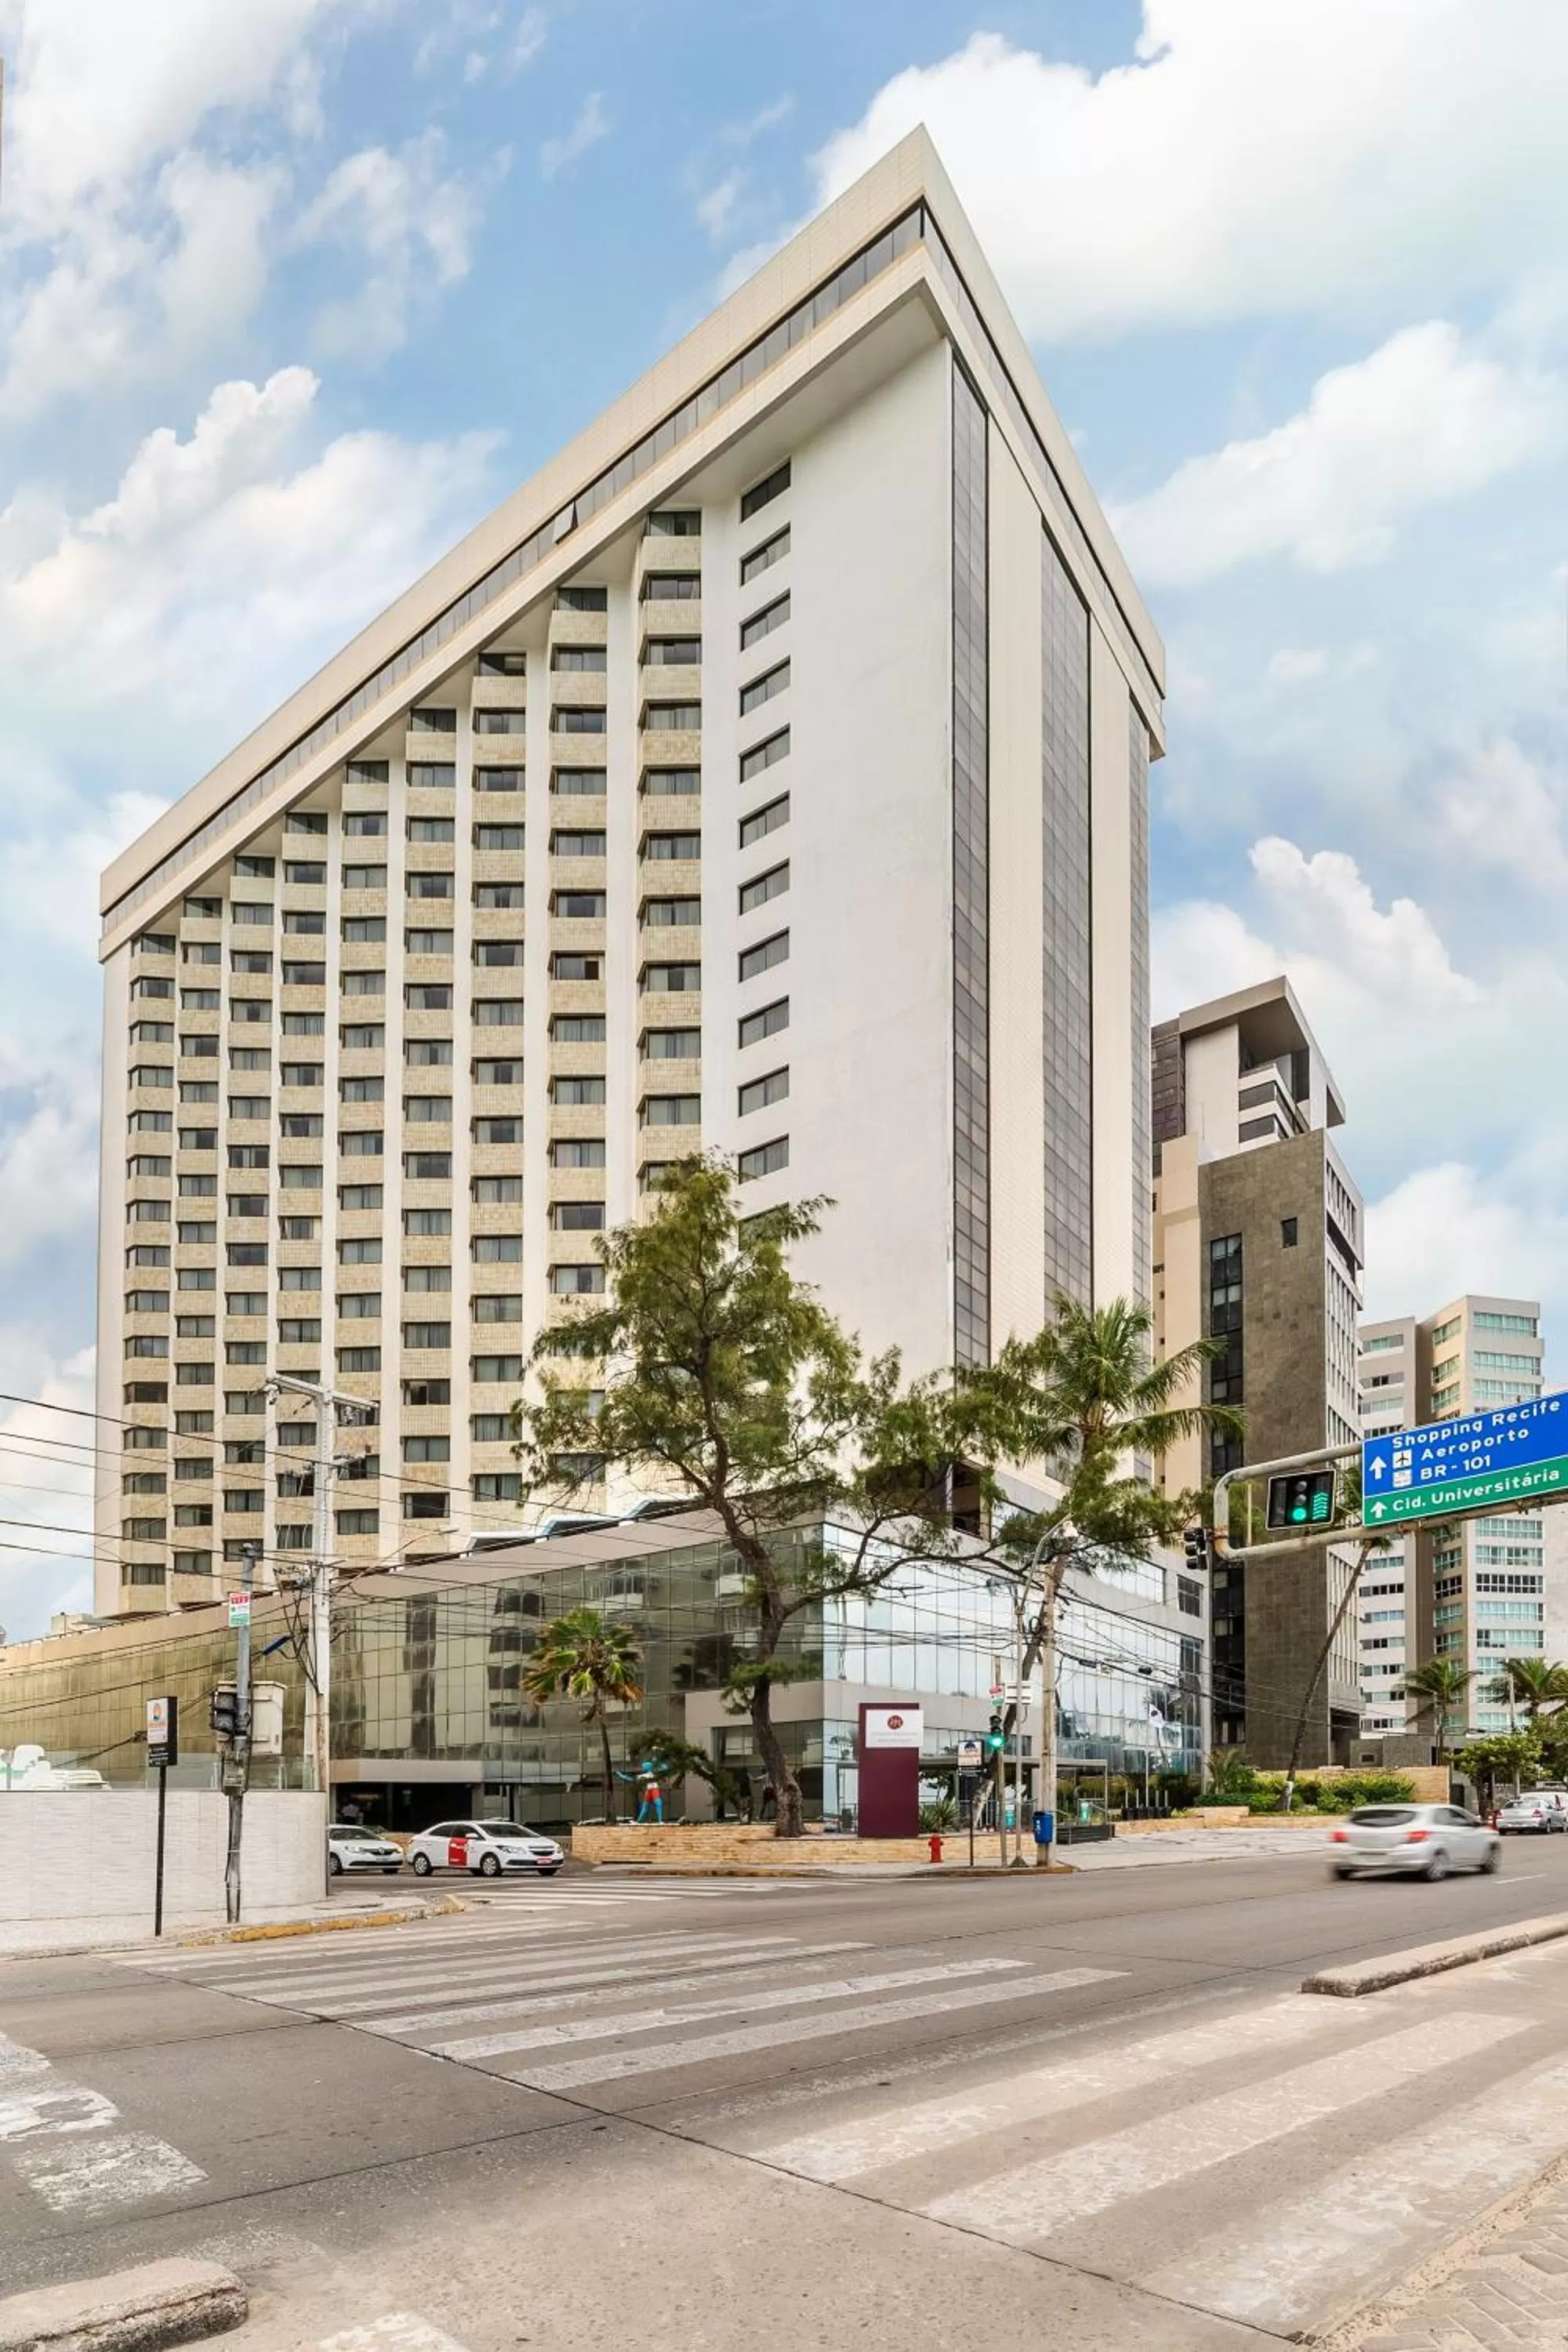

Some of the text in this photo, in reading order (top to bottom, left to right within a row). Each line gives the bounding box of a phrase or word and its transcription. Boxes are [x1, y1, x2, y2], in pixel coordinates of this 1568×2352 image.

[1392, 1399, 1561, 1449] Shopping Recife
[1421, 1428, 1529, 1461] Aeroporto
[1392, 1468, 1560, 1512] Cid. Universitária
